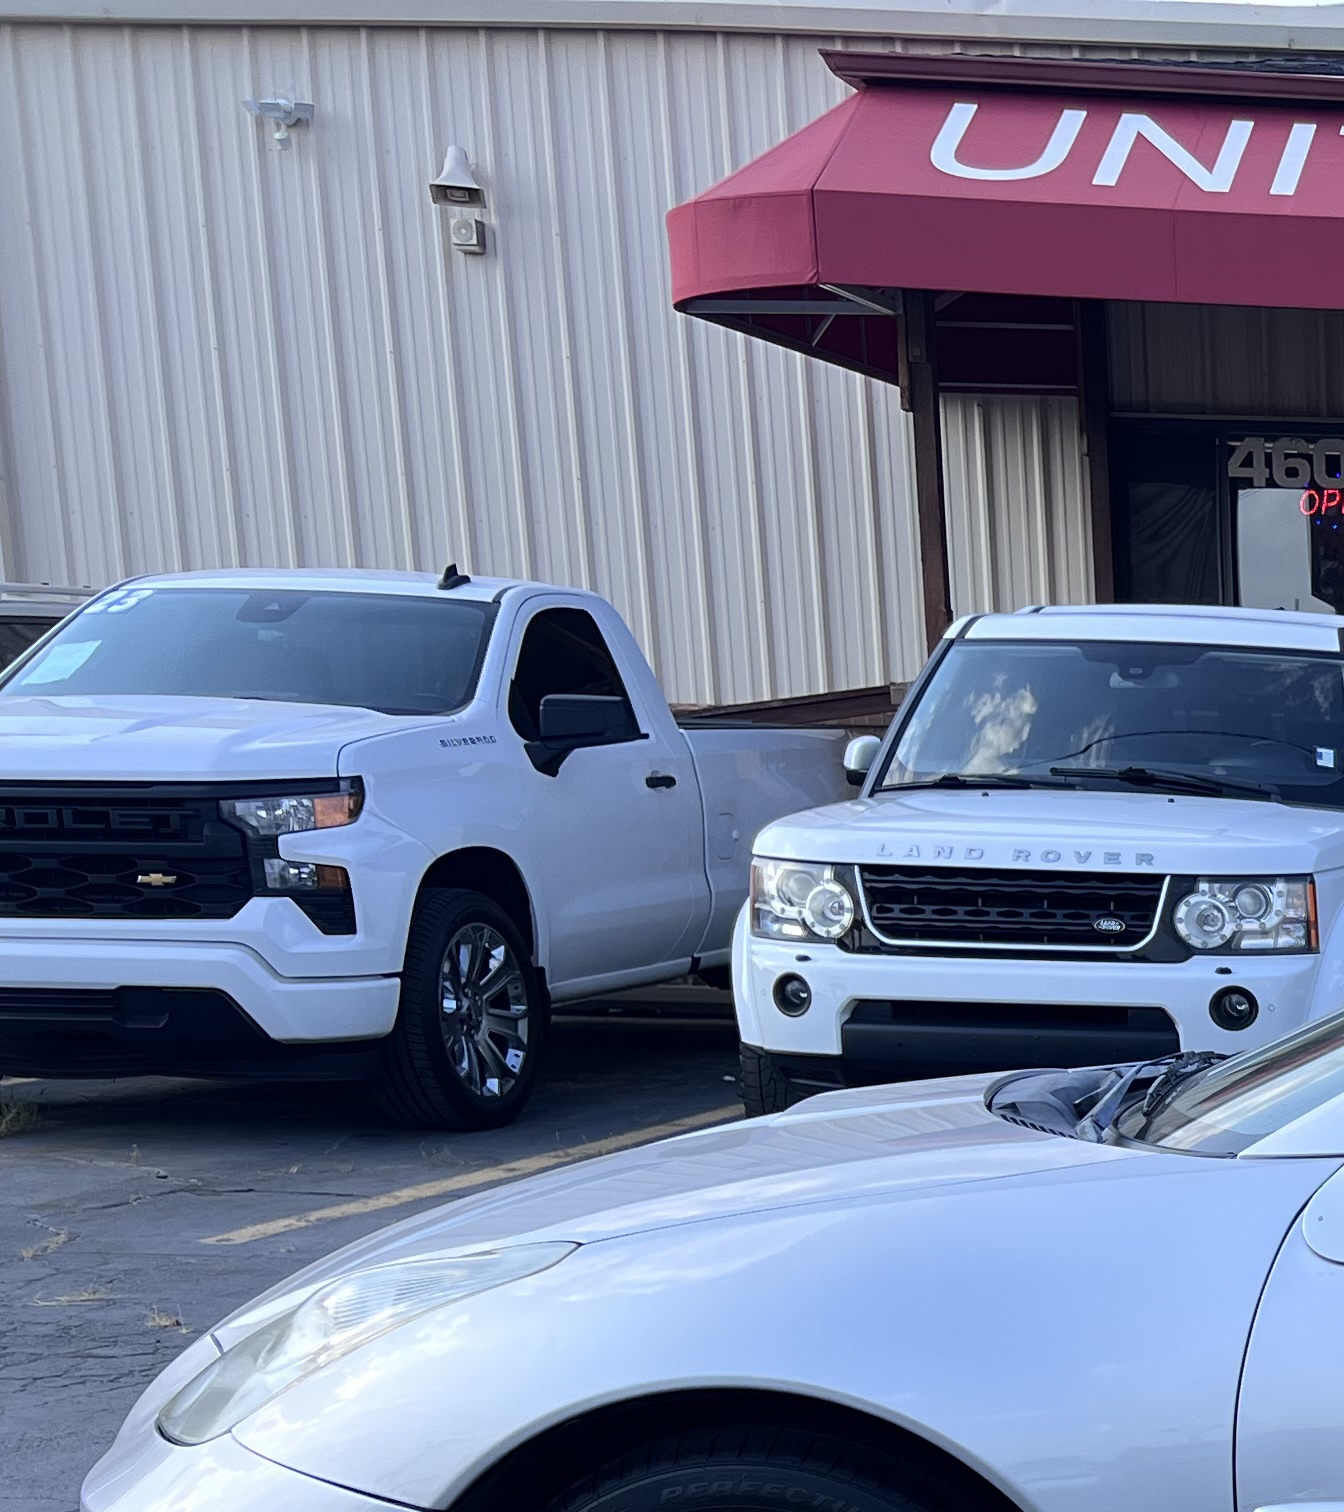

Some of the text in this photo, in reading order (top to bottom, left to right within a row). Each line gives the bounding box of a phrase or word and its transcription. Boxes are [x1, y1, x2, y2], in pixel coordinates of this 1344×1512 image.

[83, 589, 156, 614] 23
[876, 844, 1154, 866] LAND ROVER
